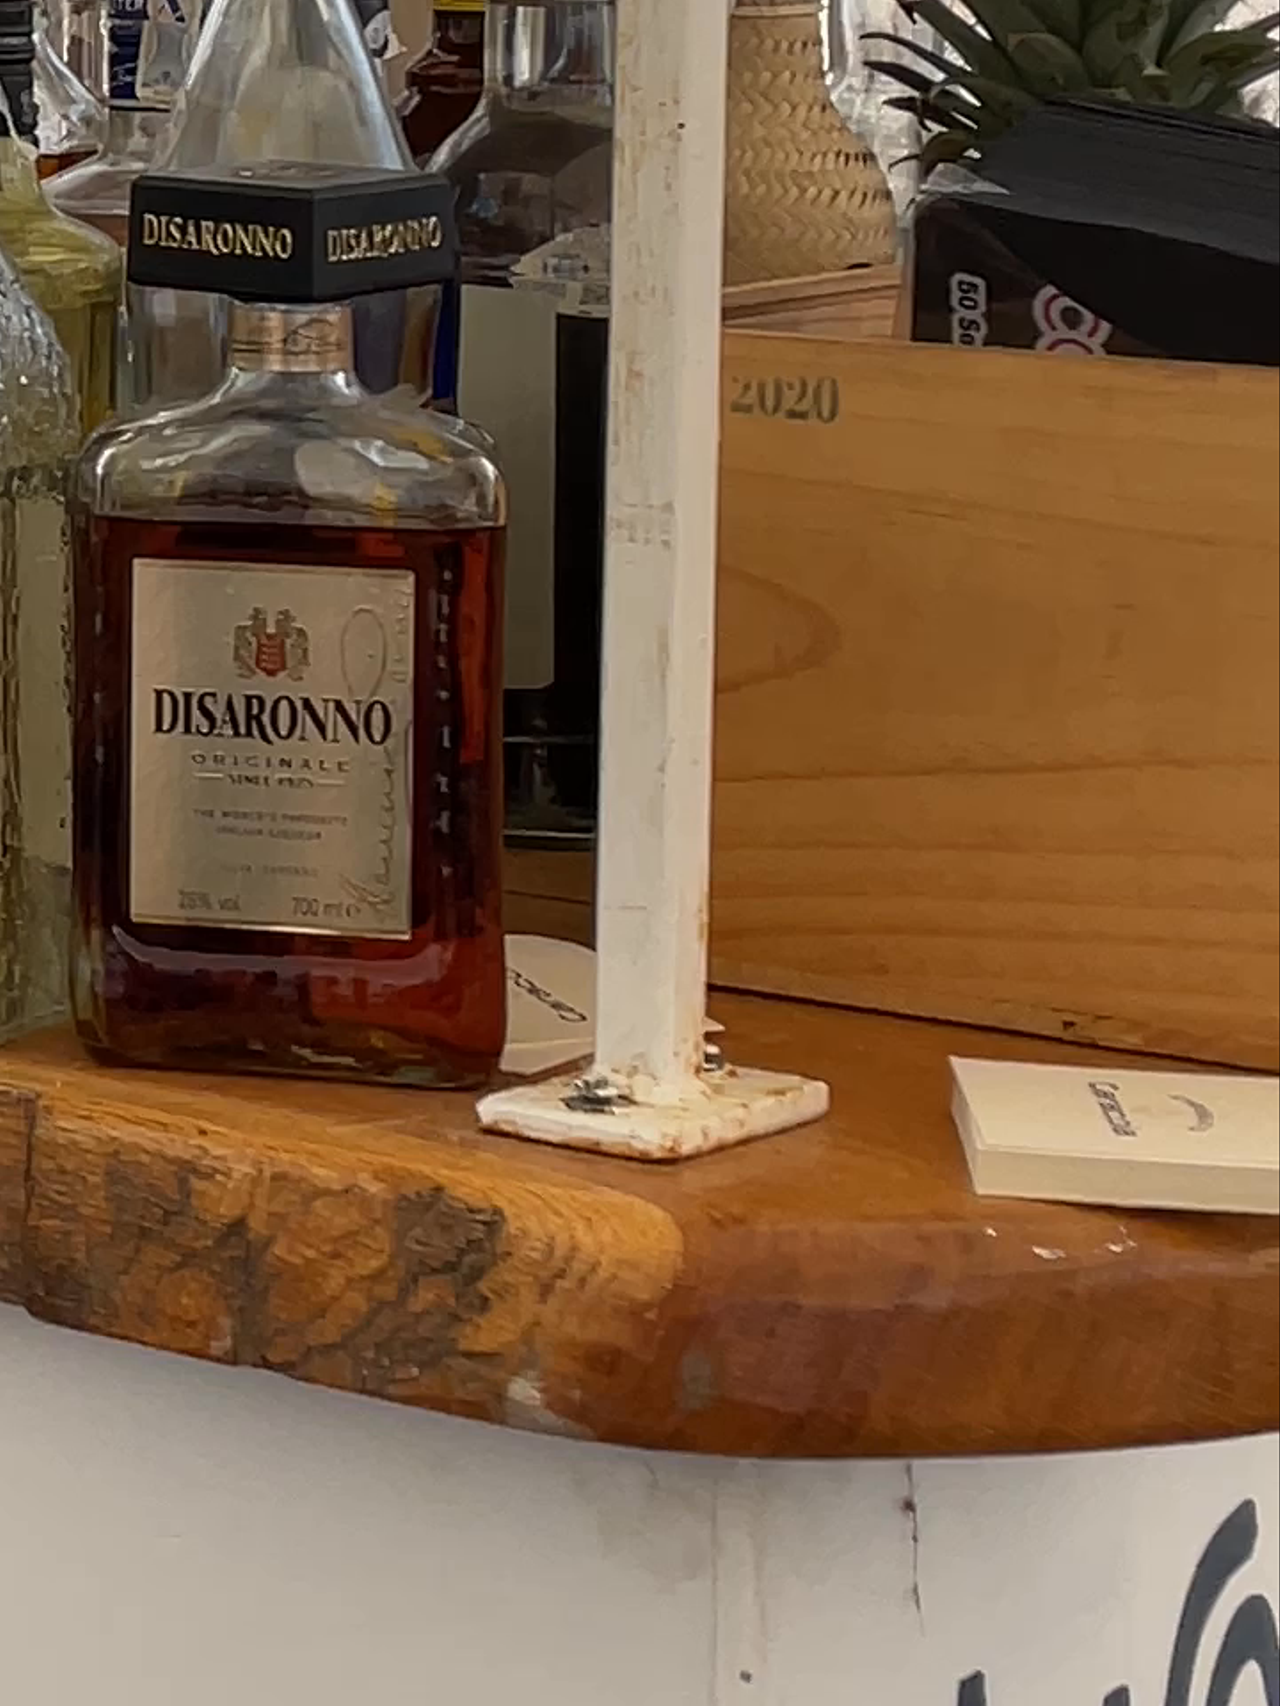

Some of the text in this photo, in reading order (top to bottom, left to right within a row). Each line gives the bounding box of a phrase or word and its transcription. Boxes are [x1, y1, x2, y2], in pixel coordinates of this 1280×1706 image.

[142, 212, 293, 260] DISARONNO
[326, 215, 441, 263] DISARONNO
[730, 374, 841, 424] 2020
[152, 687, 393, 746] DISARONNO
